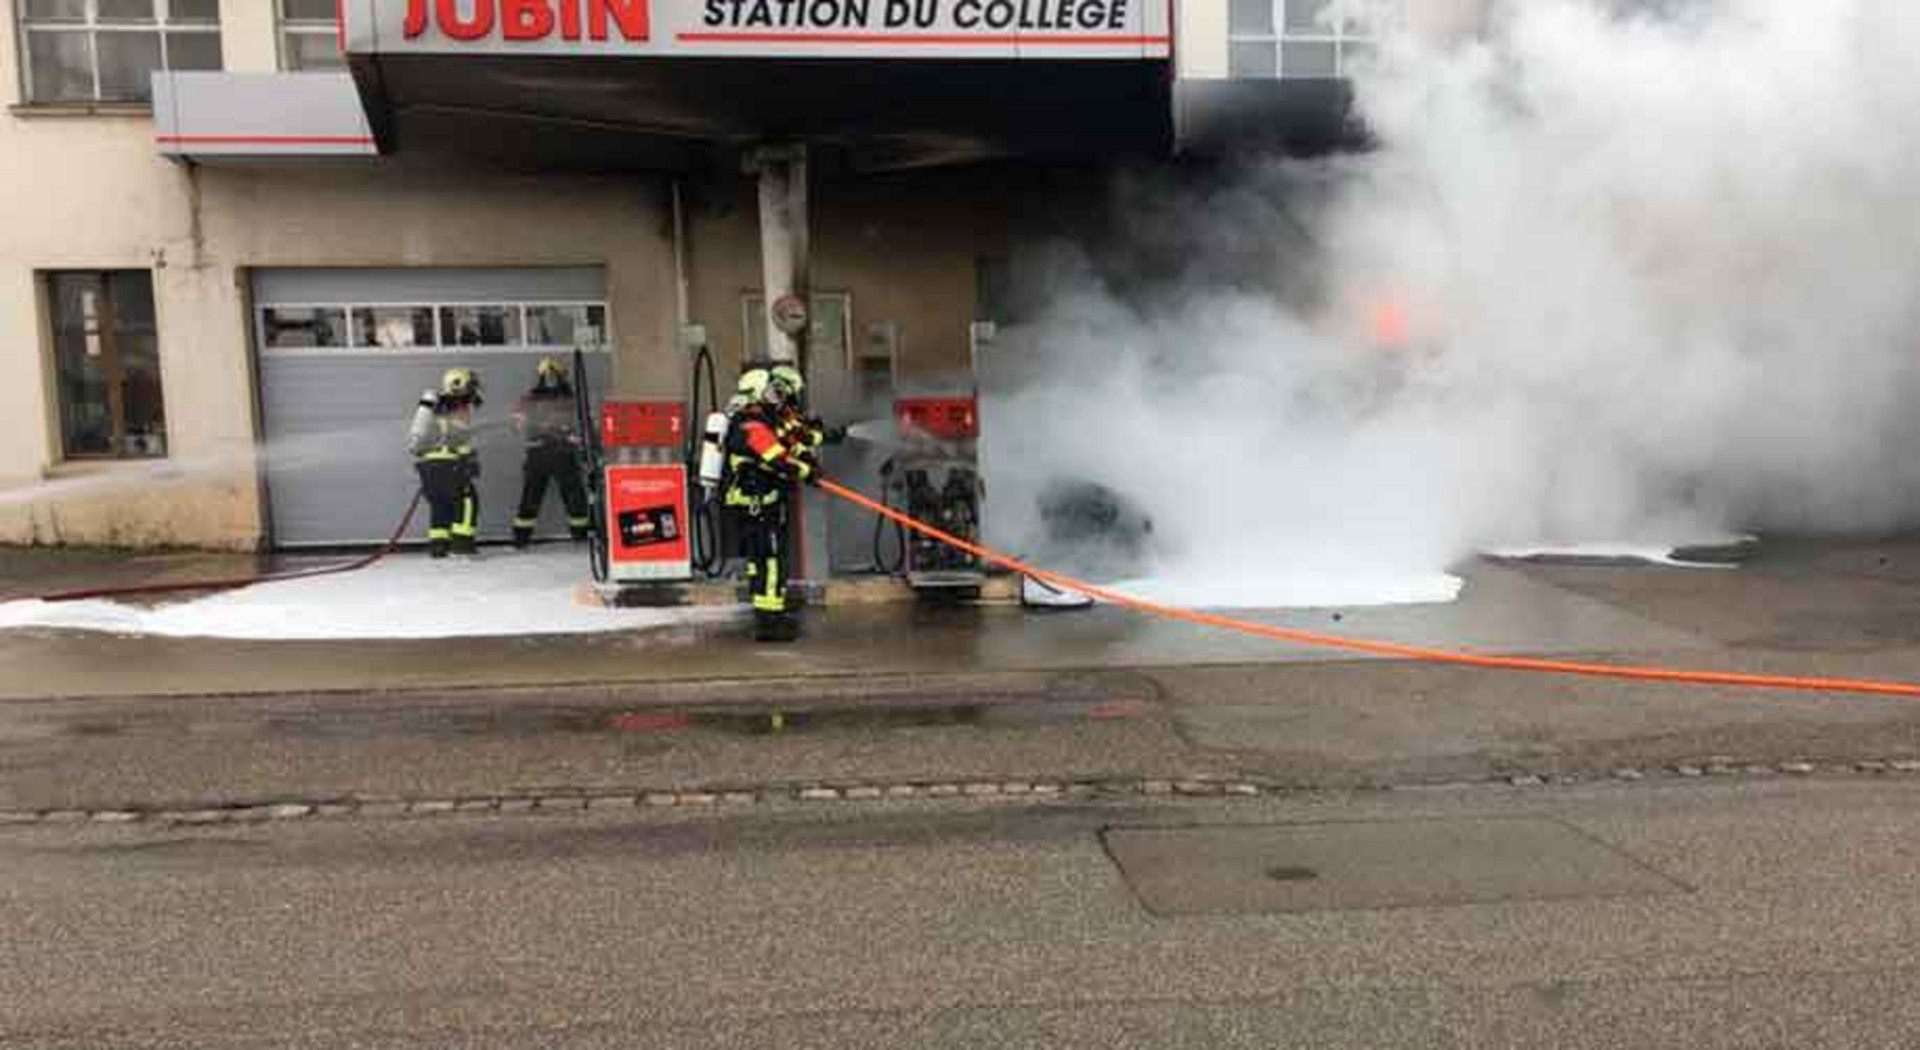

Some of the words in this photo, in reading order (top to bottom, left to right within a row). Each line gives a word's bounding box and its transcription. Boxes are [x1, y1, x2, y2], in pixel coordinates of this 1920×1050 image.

[403, 0, 650, 41] JUBIN
[704, 0, 870, 27] STATION
[884, 0, 938, 28] DU
